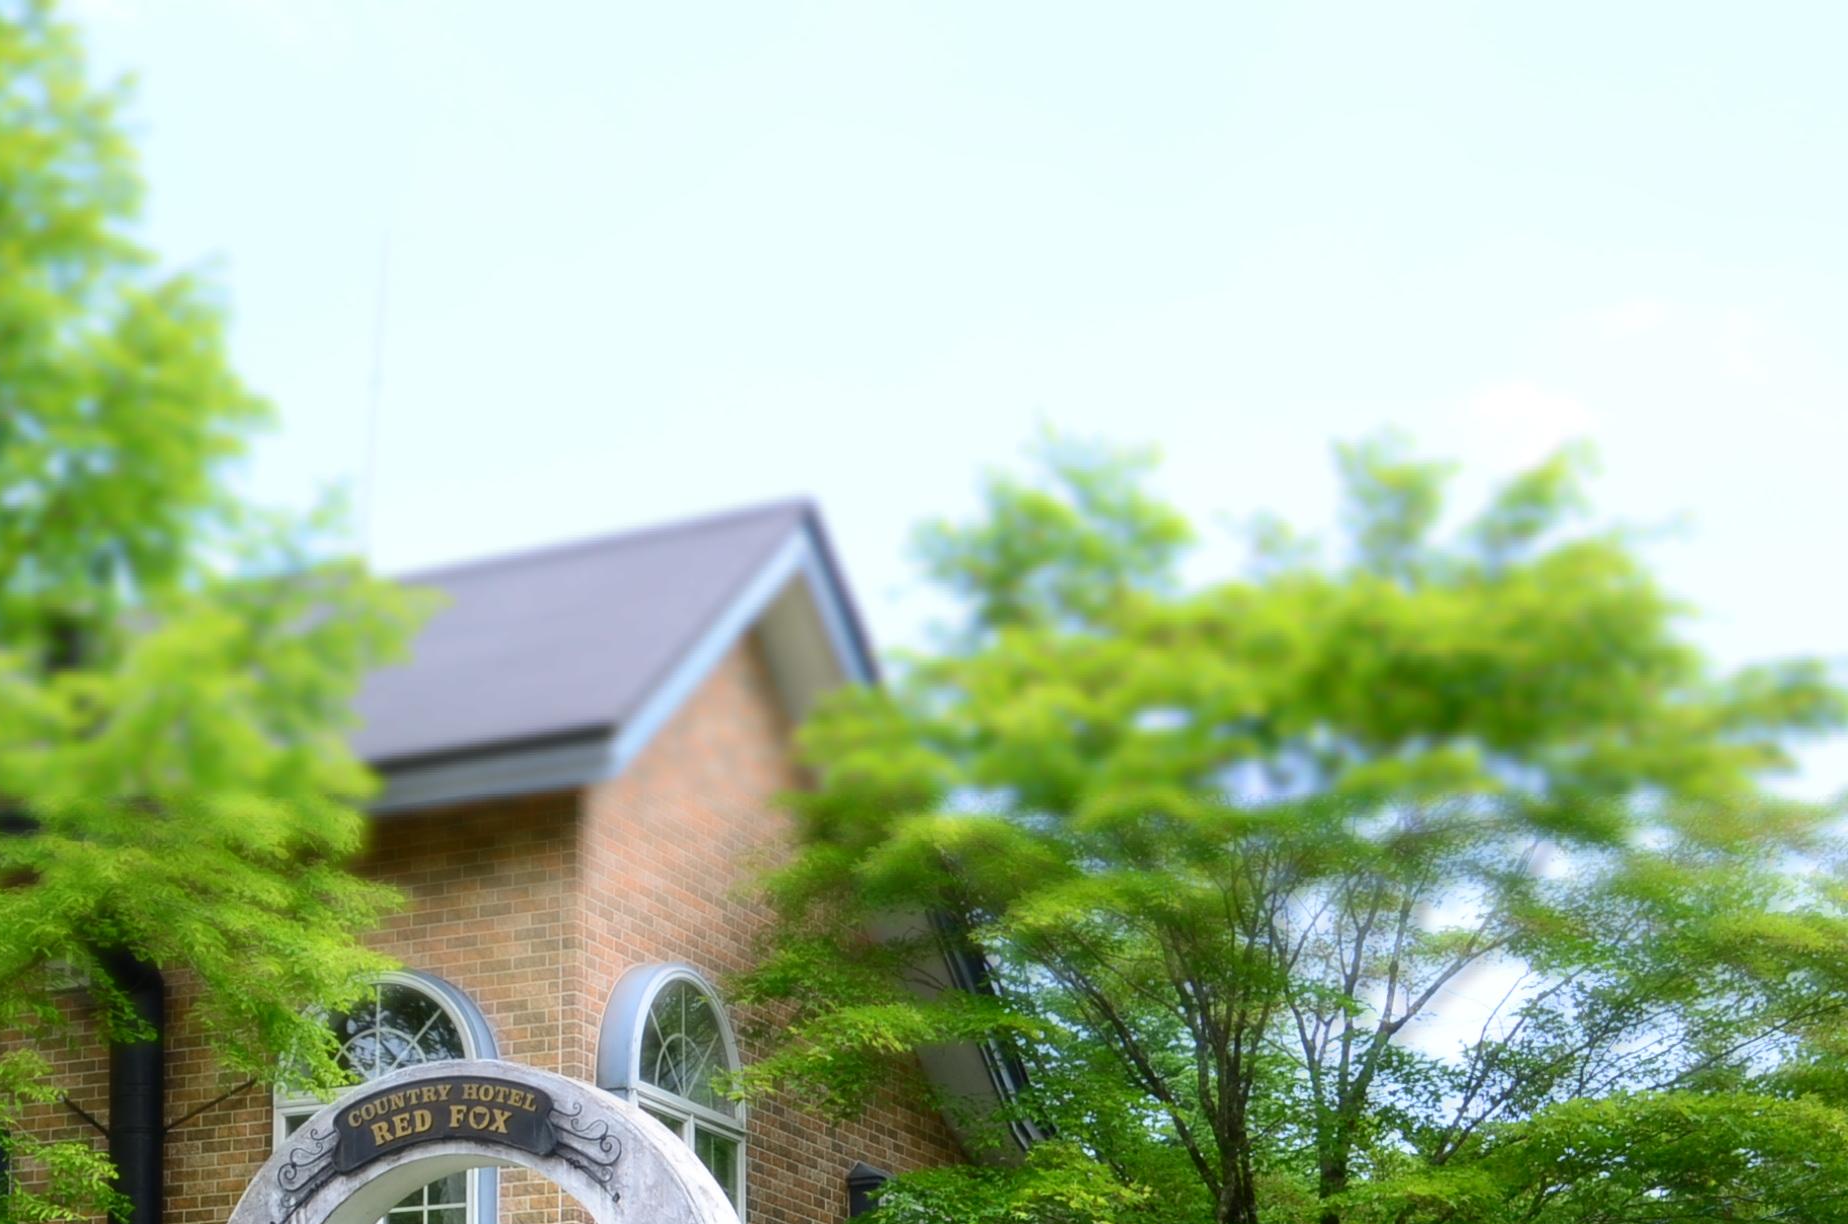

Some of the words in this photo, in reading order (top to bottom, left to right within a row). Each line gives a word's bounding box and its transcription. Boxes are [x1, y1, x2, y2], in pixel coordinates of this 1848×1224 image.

[348, 1085, 451, 1127] COUNTRY
[463, 1084, 536, 1111] HOTEL
[371, 1109, 432, 1146] RED
[449, 1106, 512, 1133] FOX
